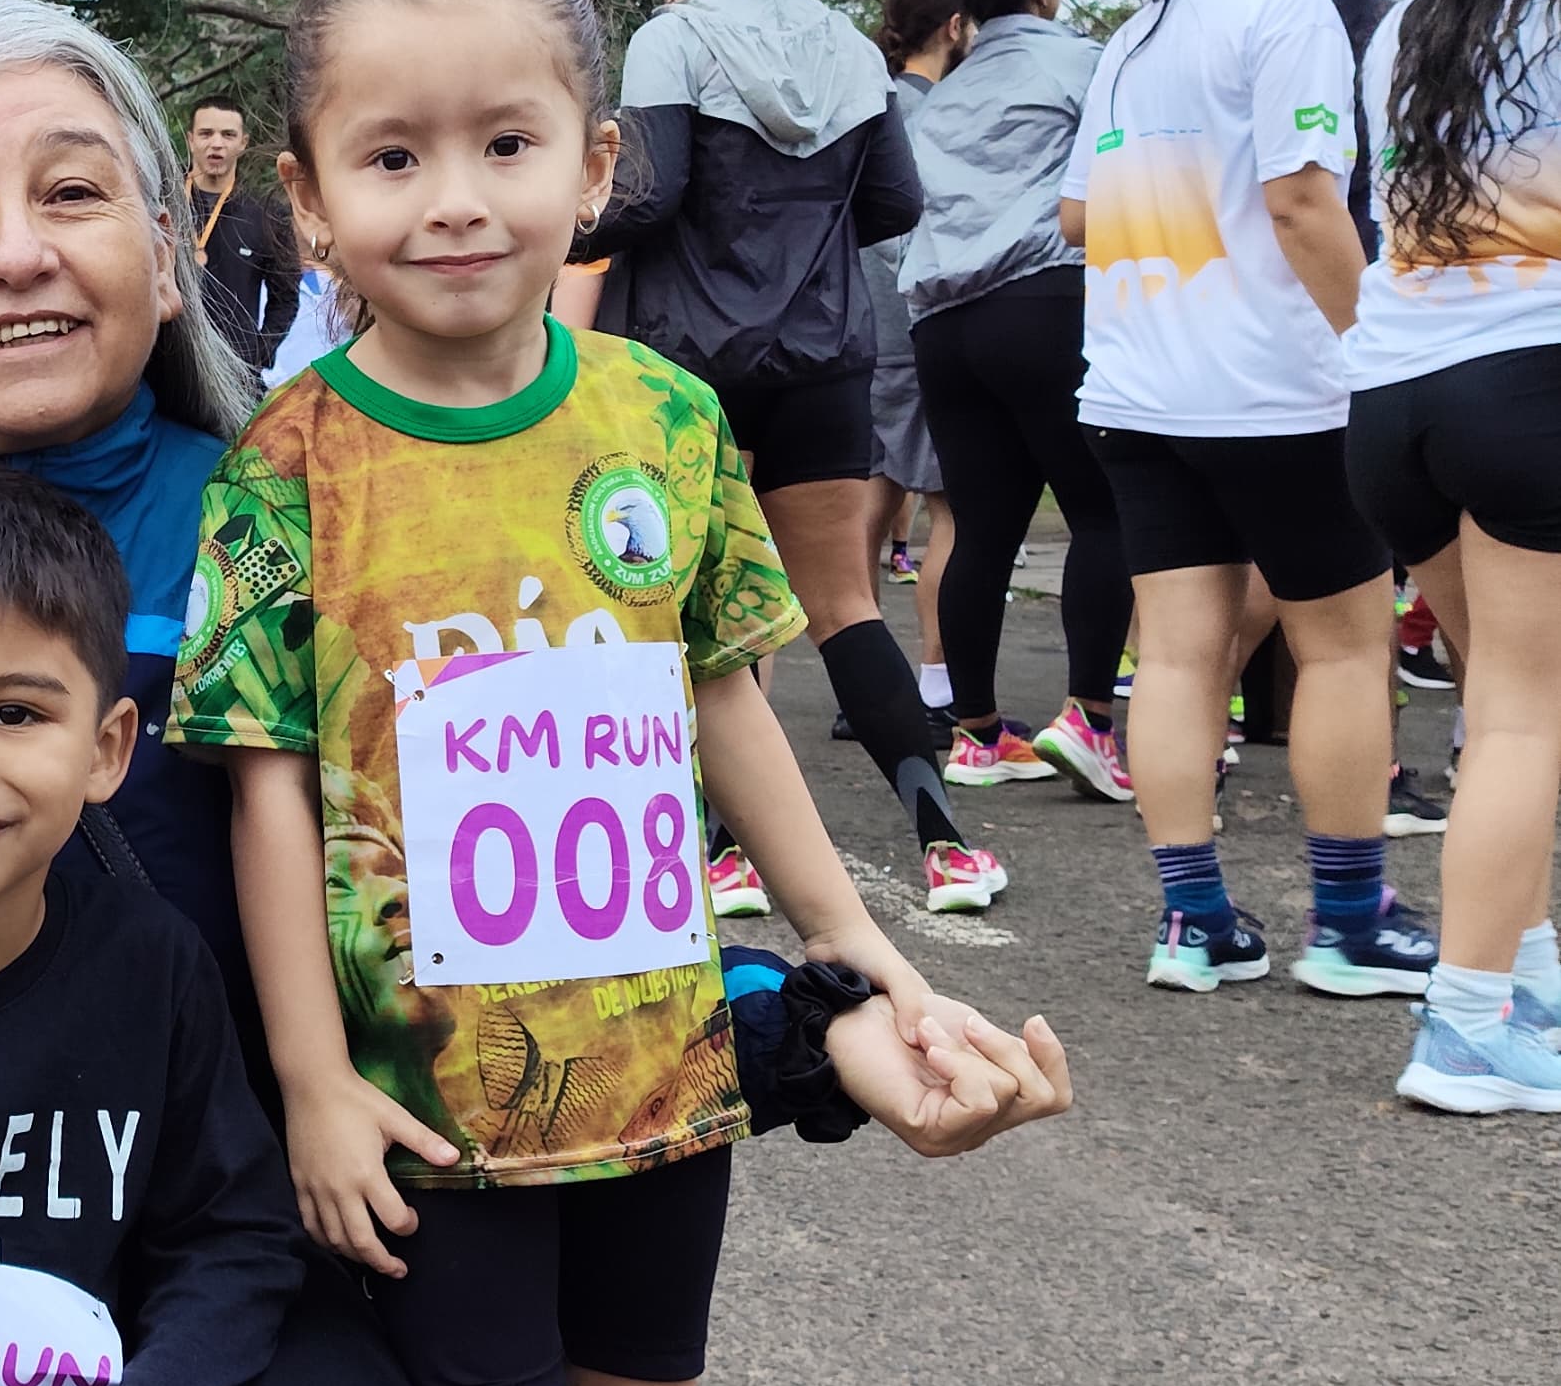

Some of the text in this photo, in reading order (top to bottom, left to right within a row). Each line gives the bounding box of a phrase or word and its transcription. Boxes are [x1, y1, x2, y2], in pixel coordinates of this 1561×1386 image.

[613, 564, 645, 585] ZUM
[183, 633, 206, 659] ZUM
[193, 638, 248, 695] CORRIENTES
[444, 708, 683, 774] KM RUN
[448, 792, 694, 947] 008
[591, 980, 624, 1021] DE
